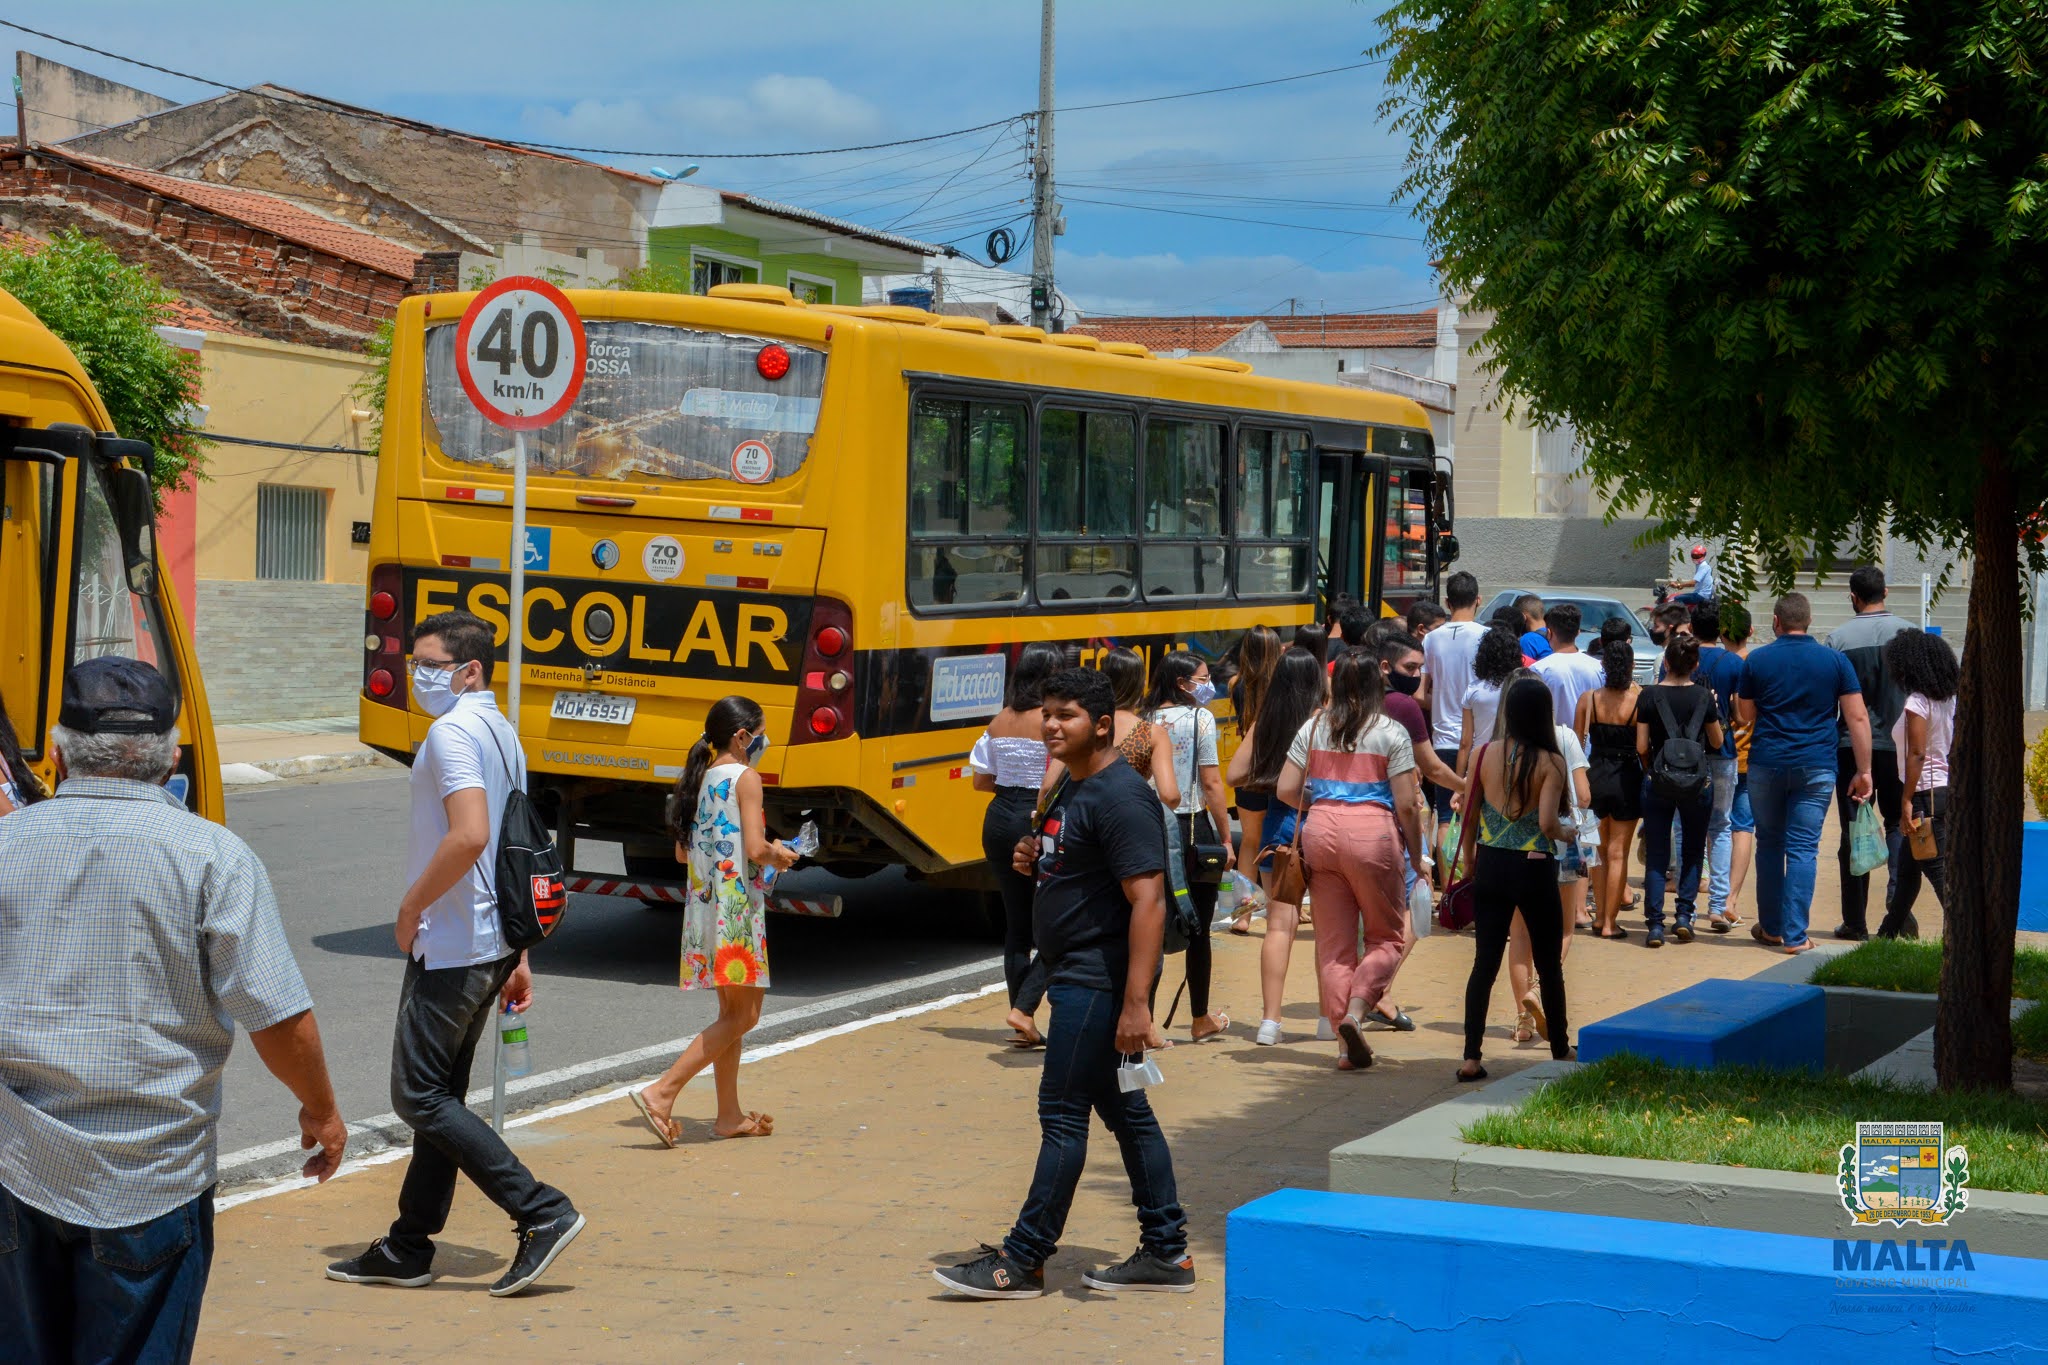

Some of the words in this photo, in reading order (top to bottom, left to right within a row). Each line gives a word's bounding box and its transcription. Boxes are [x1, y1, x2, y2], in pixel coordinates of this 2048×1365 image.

[477, 308, 559, 379] 40
[589, 341, 631, 359] força
[586, 358, 632, 375] OSSA
[493, 380, 544, 400] km/h
[729, 399, 768, 414] Malta
[745, 448, 759, 459] 70
[651, 545, 679, 558] 70
[652, 557, 677, 566] km/h
[415, 579, 789, 671] ESCOLAR
[530, 668, 582, 682] Mantenha
[606, 674, 656, 688] Distância
[936, 662, 1000, 706] Educação
[543, 749, 650, 770] VOLKSWAGEN
[992, 1267, 1010, 1288] C
